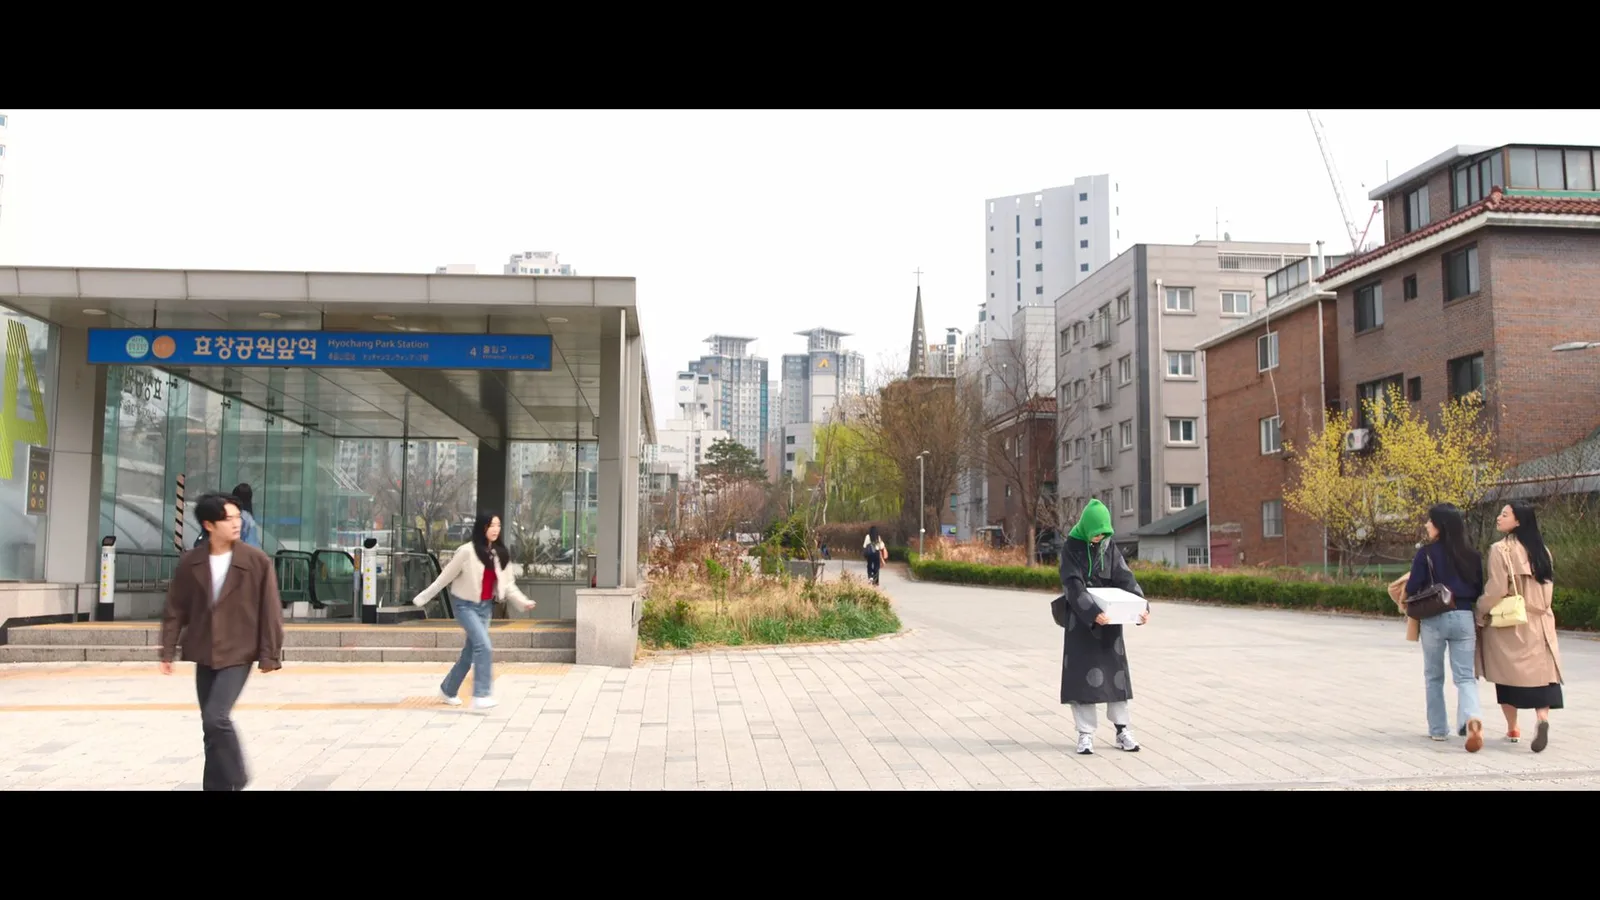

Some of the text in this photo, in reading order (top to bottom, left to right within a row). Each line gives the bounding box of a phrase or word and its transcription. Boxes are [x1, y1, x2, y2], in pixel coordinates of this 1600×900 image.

[193, 336, 317, 360] 효창공원앞역
[328, 339, 429, 350] Hyochang Park Station
[469, 346, 477, 357] 4
